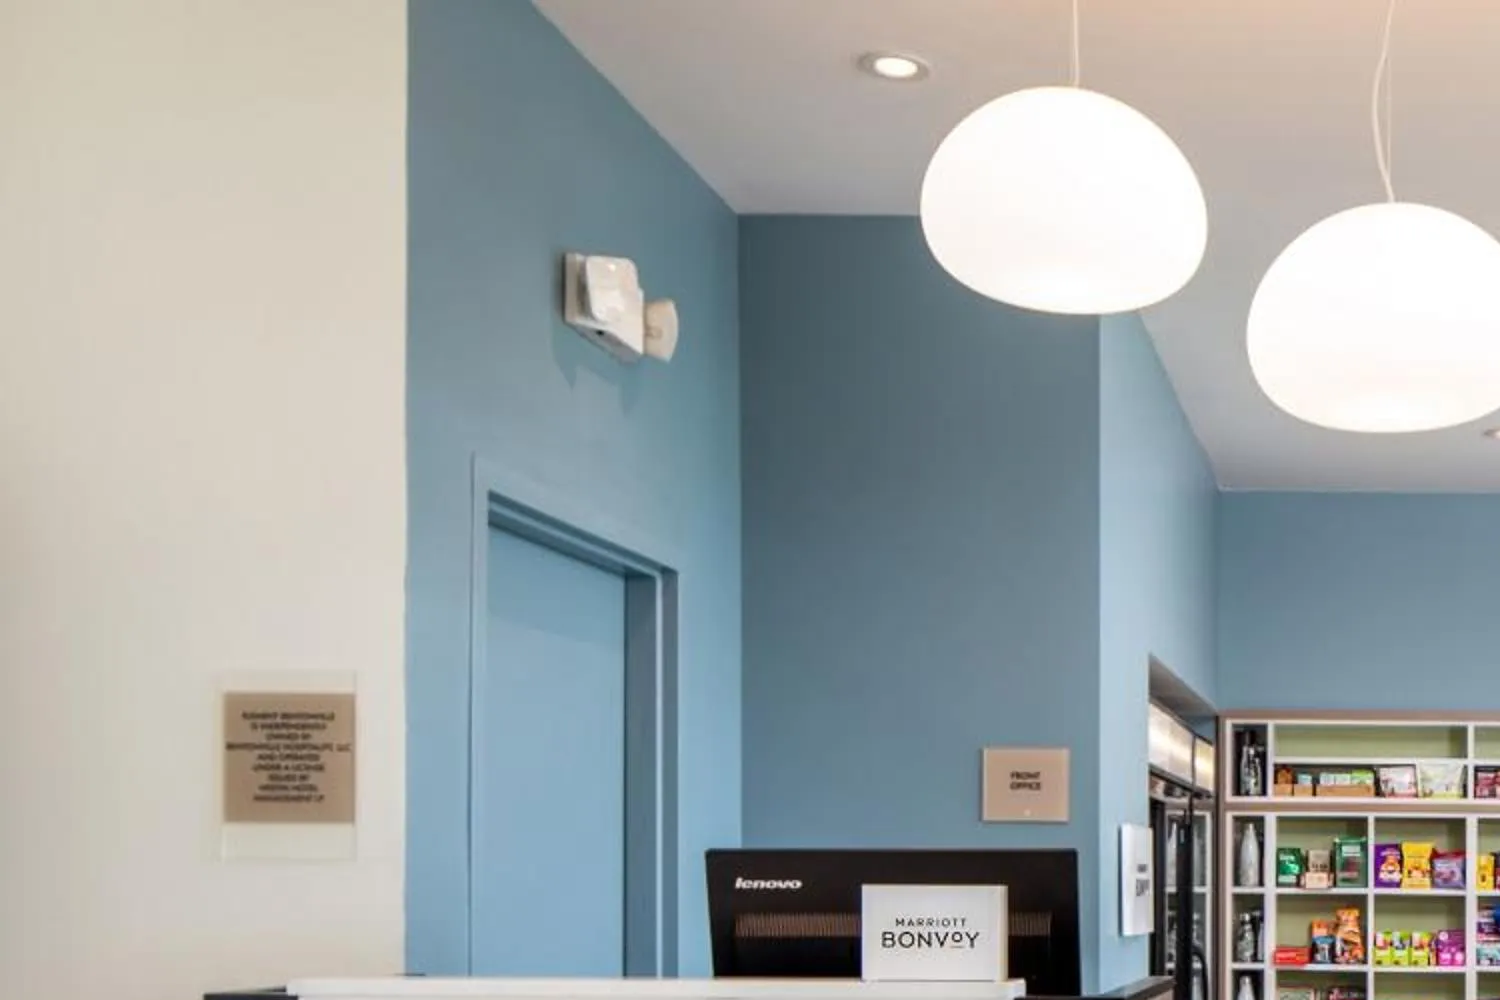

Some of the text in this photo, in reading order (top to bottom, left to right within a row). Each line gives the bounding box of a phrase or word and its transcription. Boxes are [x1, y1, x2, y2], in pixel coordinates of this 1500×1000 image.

[734, 876, 802, 890] lenovo
[895, 917, 968, 928] MARRIOTT
[881, 930, 980, 950] BONVOY
